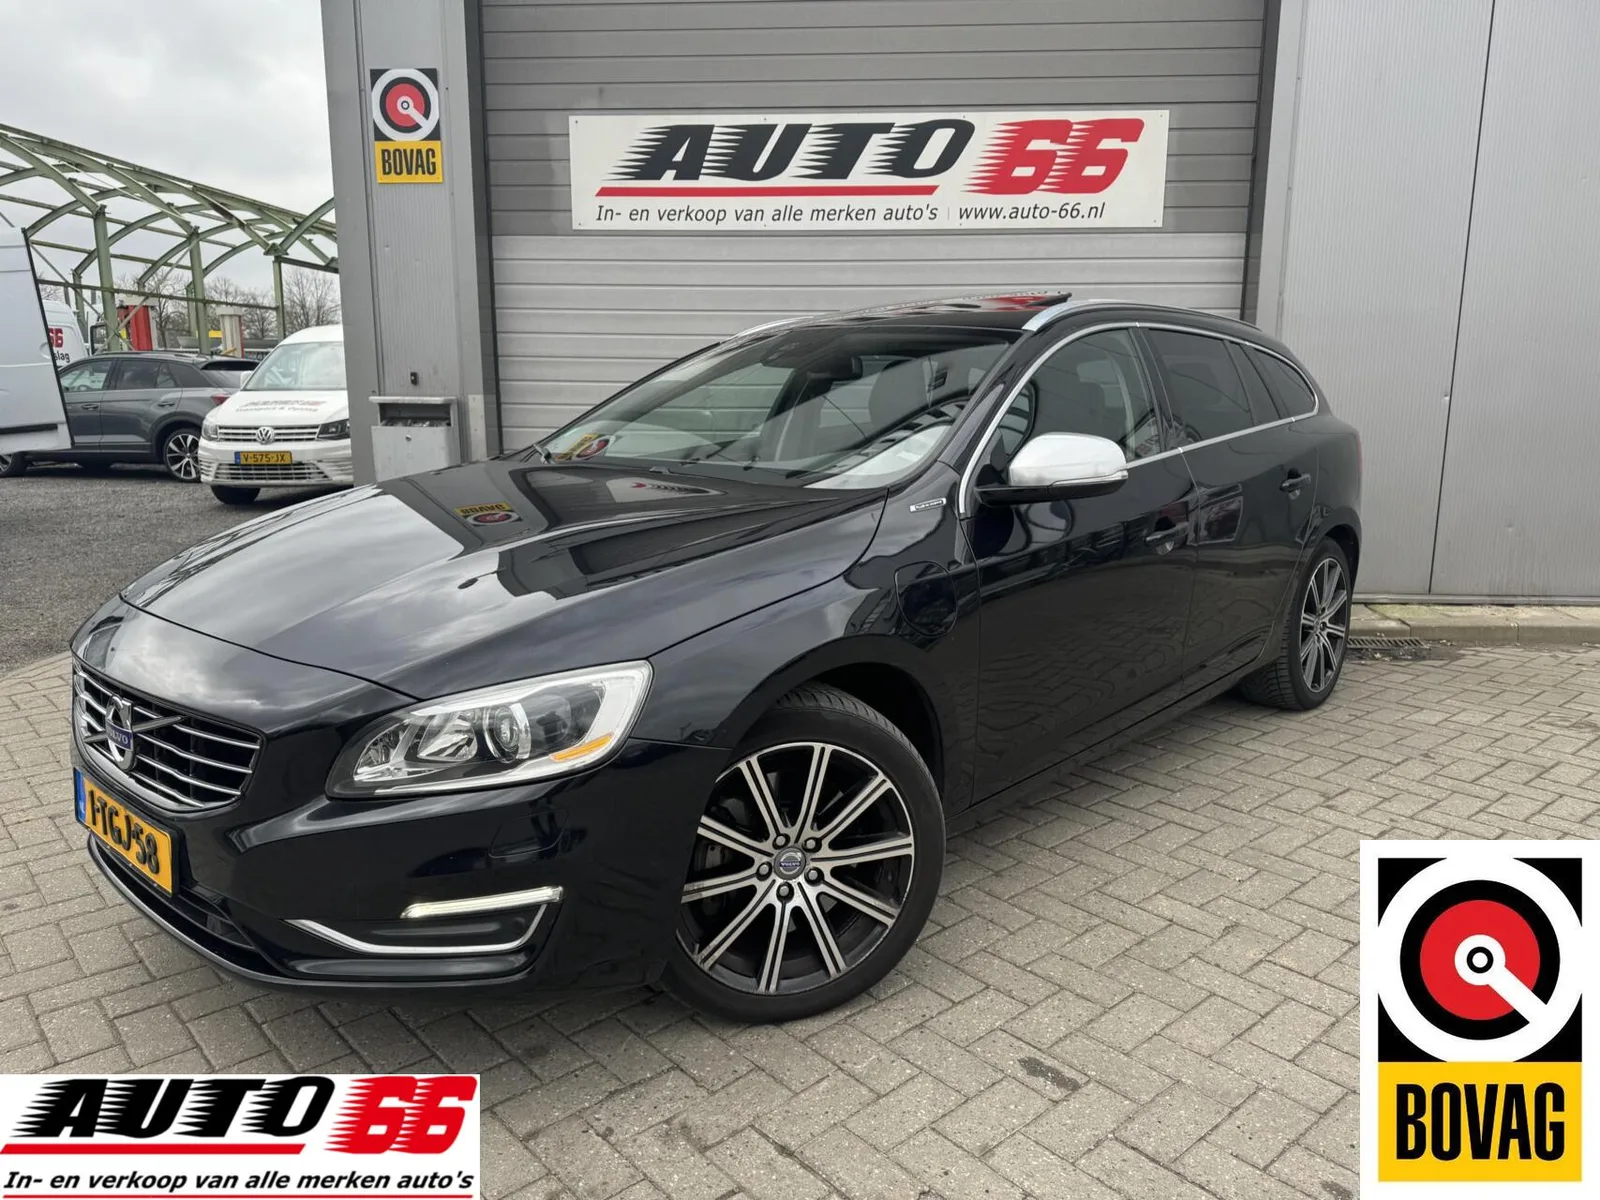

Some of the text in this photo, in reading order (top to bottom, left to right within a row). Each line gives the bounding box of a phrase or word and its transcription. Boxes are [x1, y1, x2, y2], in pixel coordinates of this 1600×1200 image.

[381, 147, 437, 176] BOVAG
[601, 117, 1146, 195] AUTO 66
[596, 202, 1106, 226] In- en verkoop van alle merken auto's www.auto-66.nl
[243, 453, 286, 463] V-575-JX
